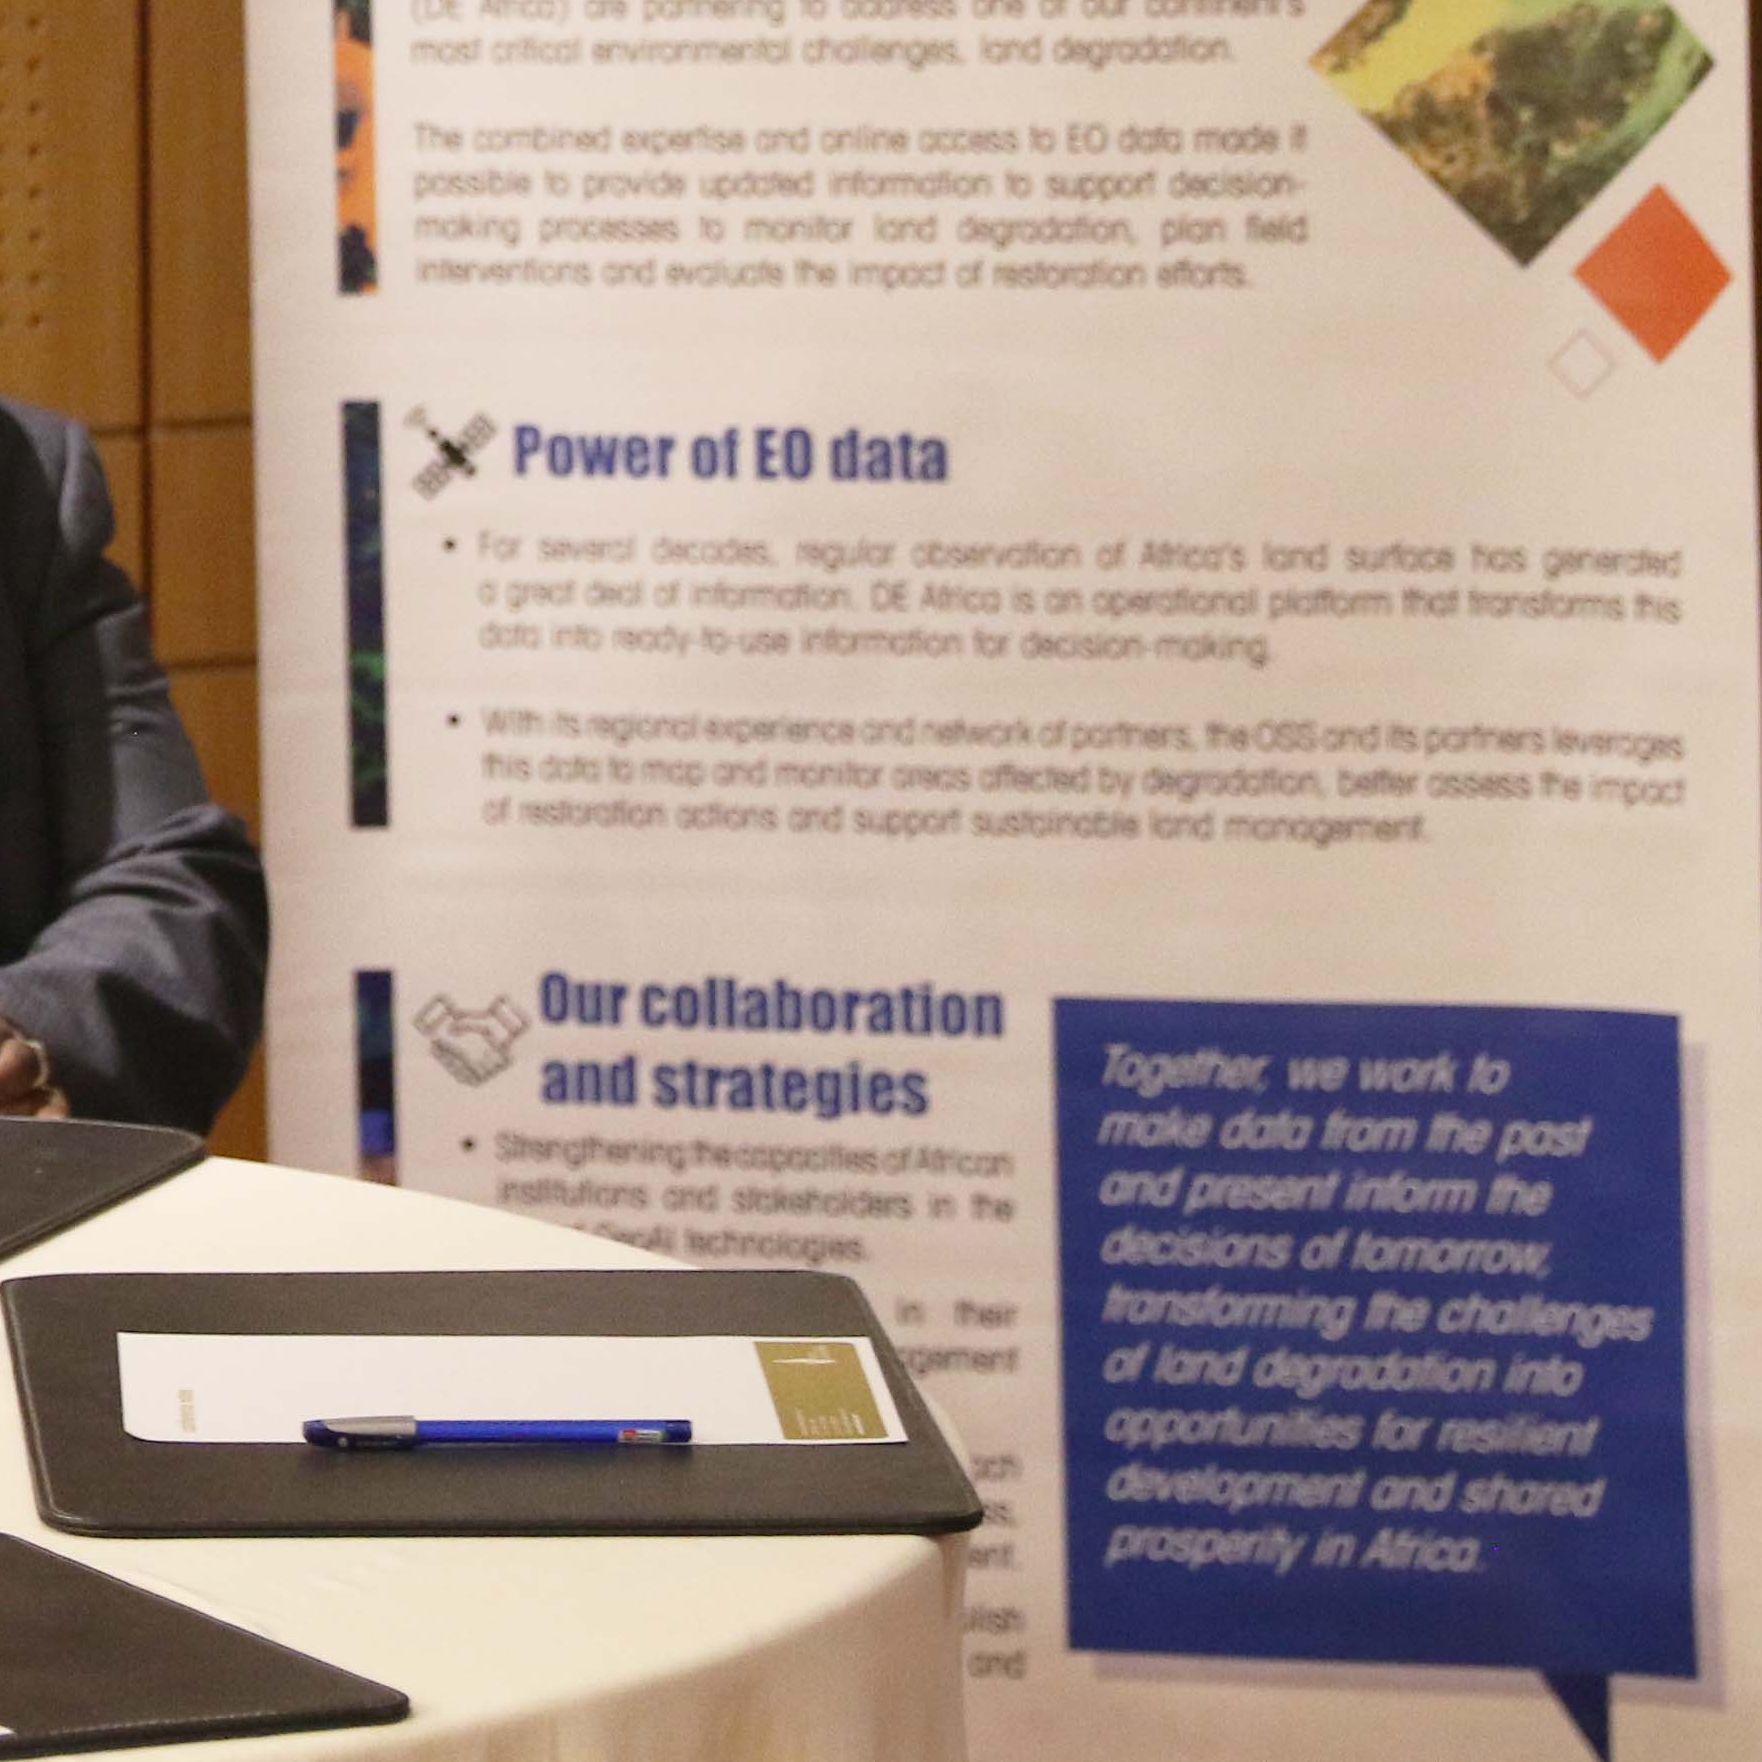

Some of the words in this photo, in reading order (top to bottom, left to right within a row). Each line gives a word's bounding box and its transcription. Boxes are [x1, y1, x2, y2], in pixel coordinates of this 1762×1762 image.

[513, 421, 676, 478] Power
[690, 427, 739, 479] of
[754, 426, 815, 484] EO
[829, 428, 949, 484] data
[538, 970, 629, 1026] Our
[639, 978, 1005, 1036] collaboration
[541, 1053, 639, 1106] and
[653, 1061, 929, 1120] strategies
